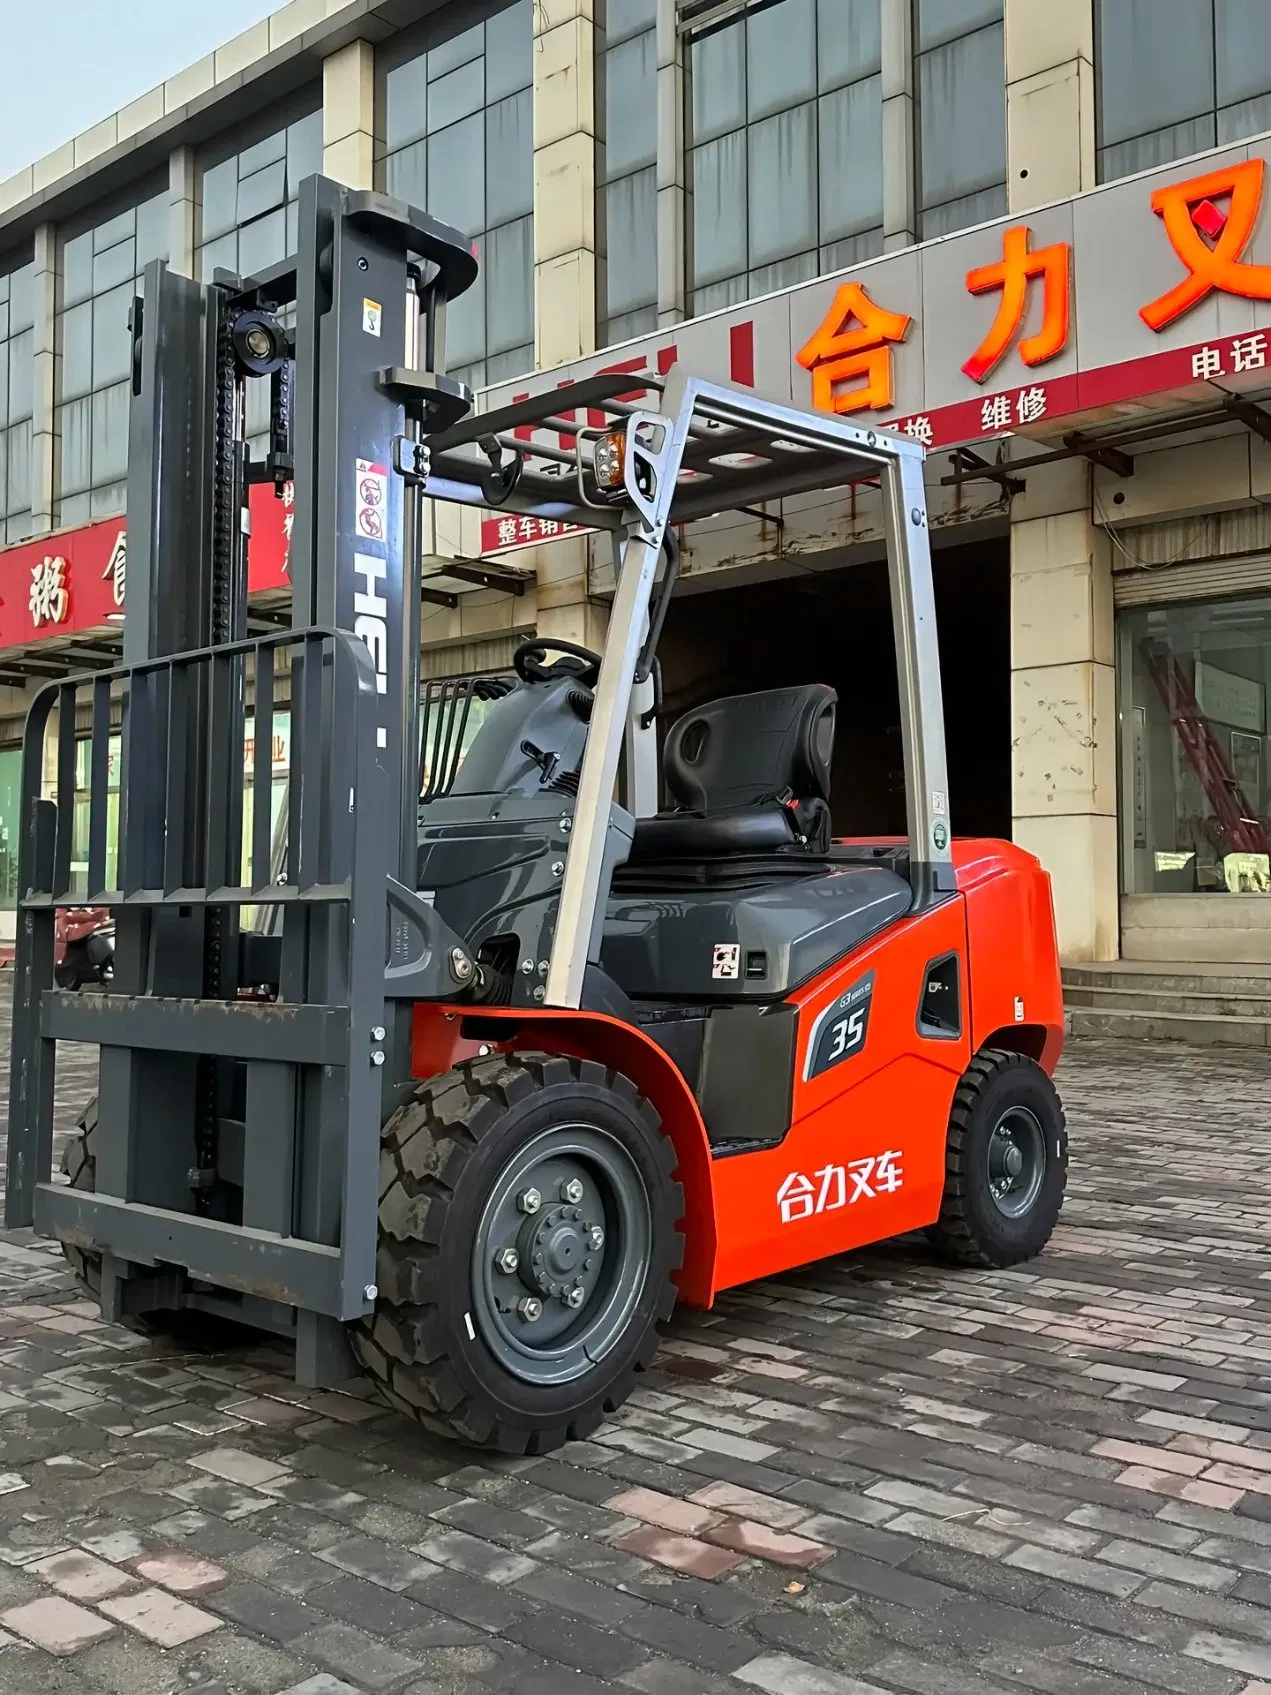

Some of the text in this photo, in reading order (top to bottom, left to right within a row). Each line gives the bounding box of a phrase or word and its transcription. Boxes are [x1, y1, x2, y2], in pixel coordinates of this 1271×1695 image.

[884, 416, 934, 446] 换
[981, 387, 1047, 432] 维修
[1191, 333, 1268, 380] 电话
[827, 1007, 866, 1061] 35
[776, 1150, 904, 1224] 合力叉车
